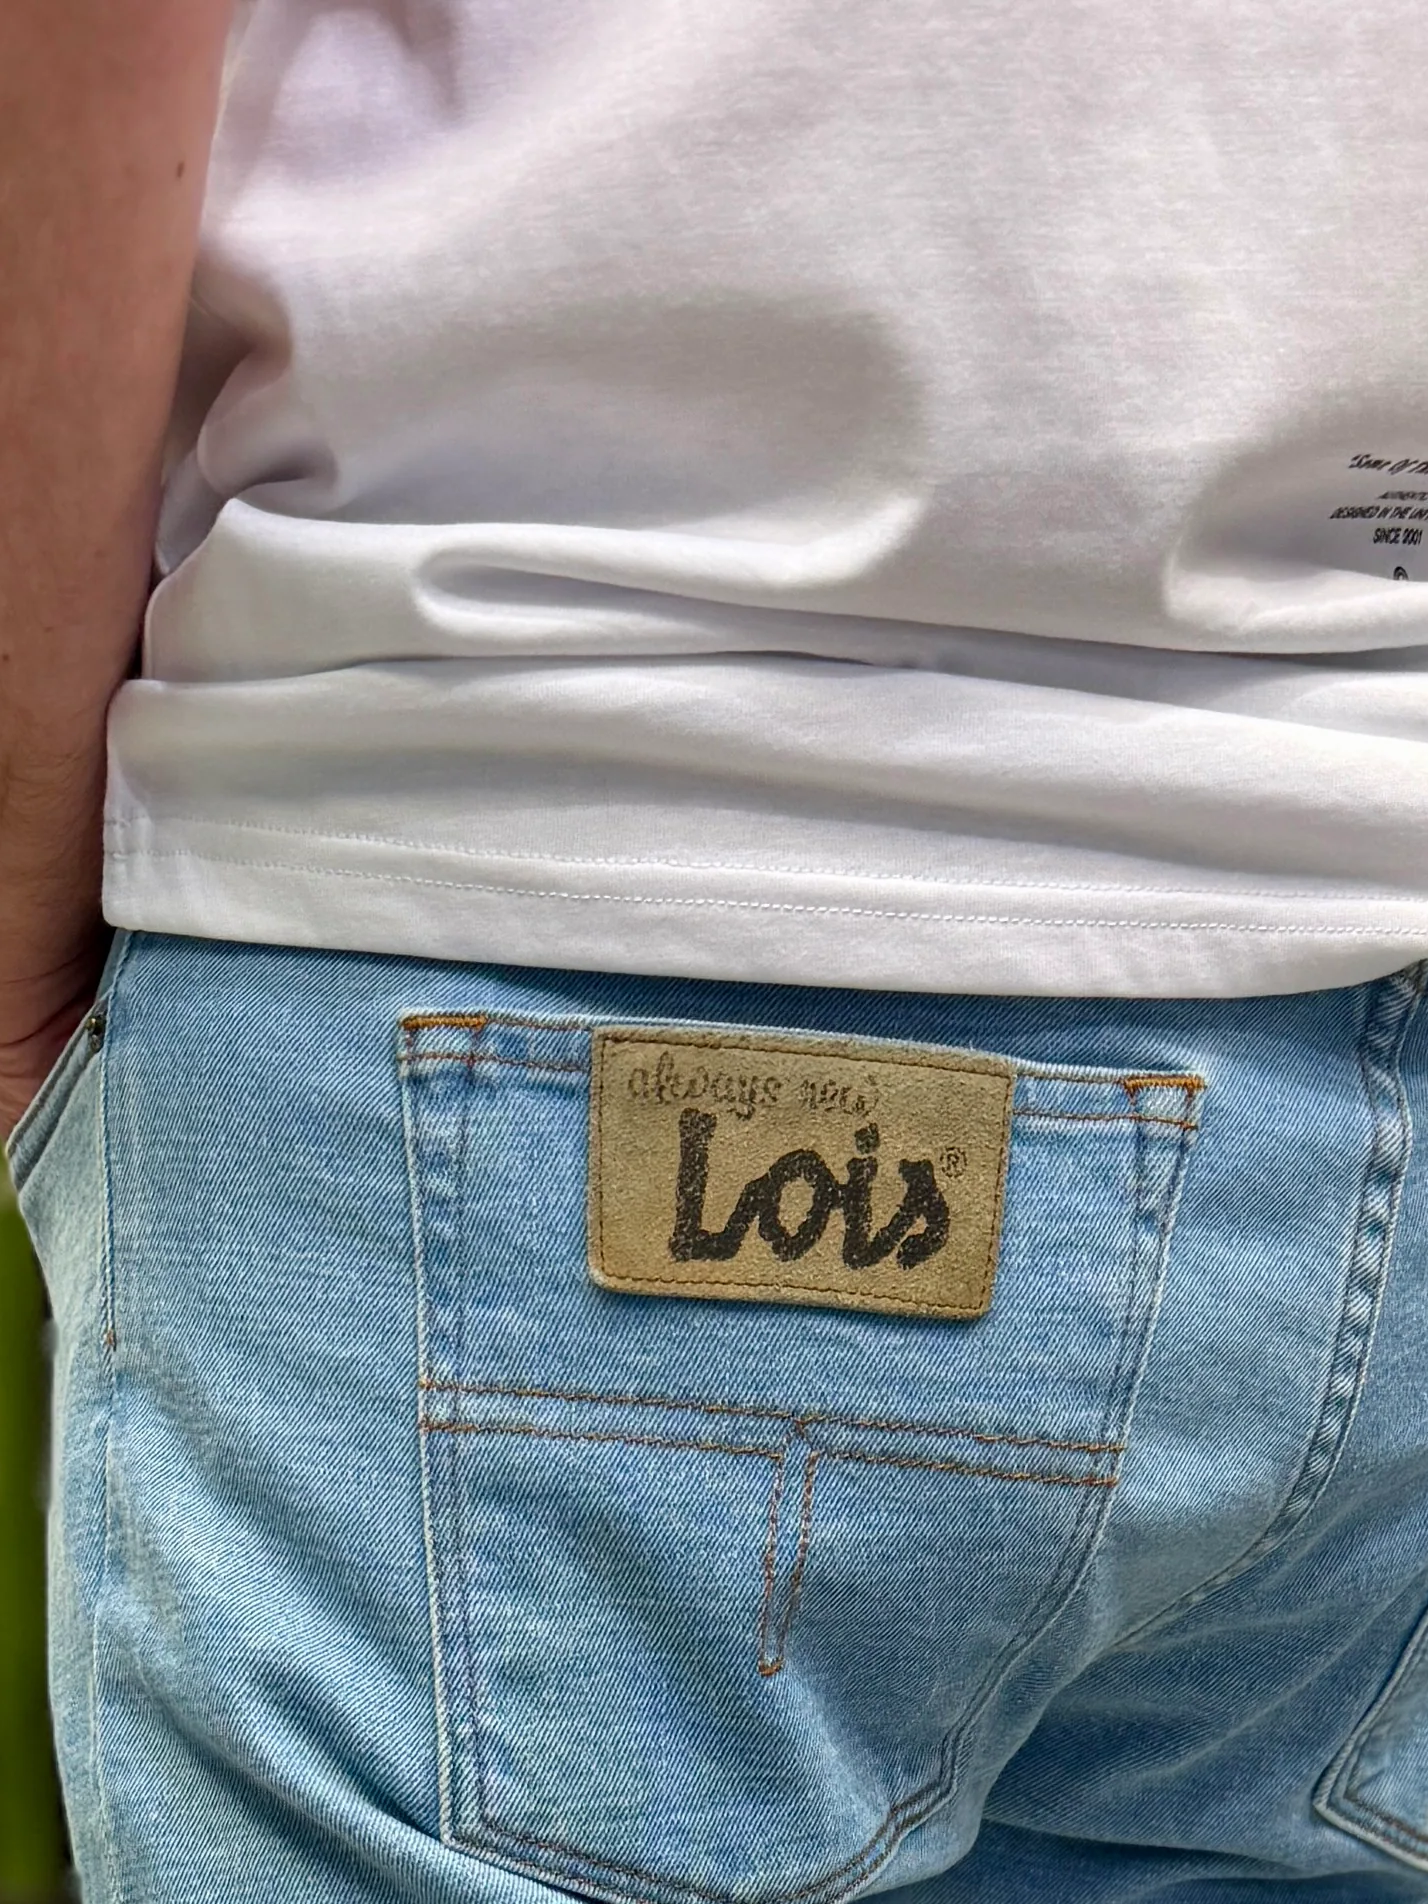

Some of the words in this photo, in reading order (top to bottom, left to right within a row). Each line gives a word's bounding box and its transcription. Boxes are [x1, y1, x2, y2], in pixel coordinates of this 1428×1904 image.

[1389, 506, 1412, 520] THE
[1373, 527, 1402, 545] SINCE
[669, 1107, 951, 1271] Lois
